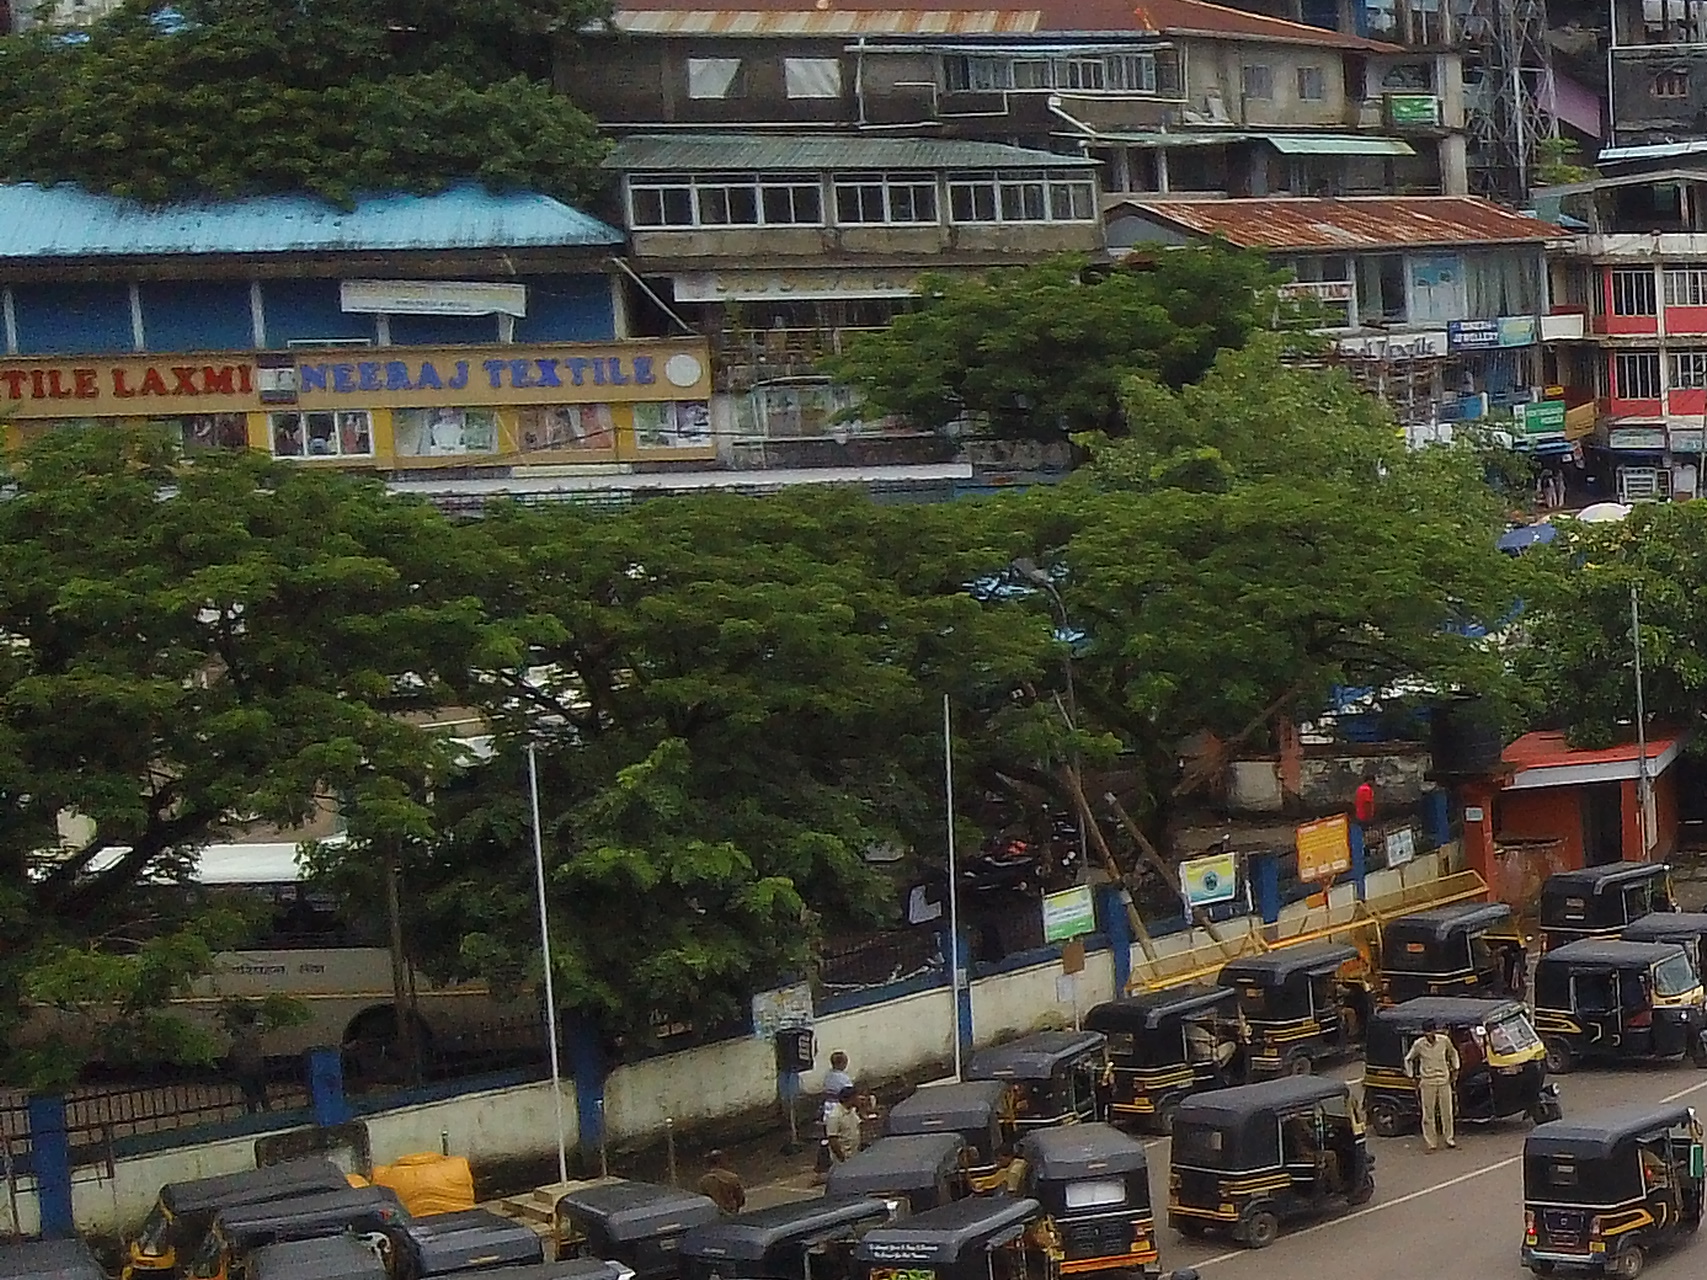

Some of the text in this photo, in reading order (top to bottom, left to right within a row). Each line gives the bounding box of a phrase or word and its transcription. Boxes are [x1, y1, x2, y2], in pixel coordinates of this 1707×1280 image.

[111, 364, 253, 398] LAXMI
[301, 356, 656, 394] NEERAJ TEXTILE
